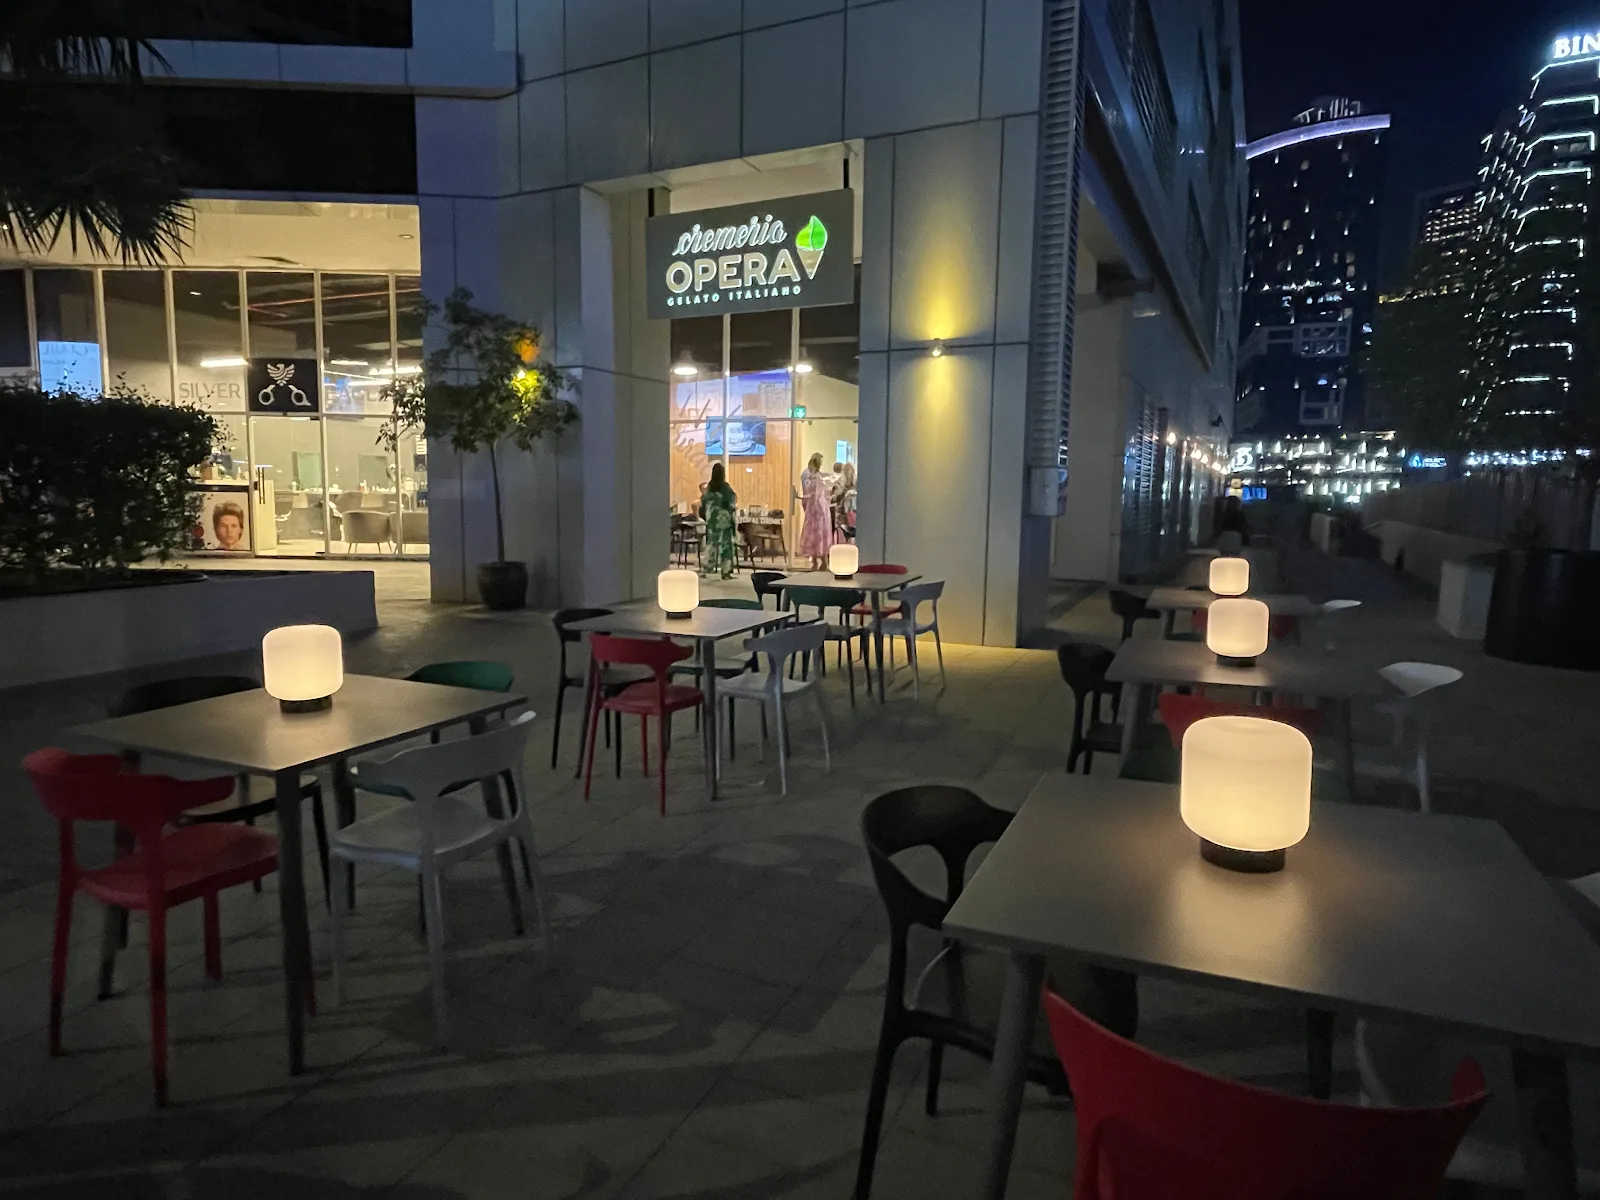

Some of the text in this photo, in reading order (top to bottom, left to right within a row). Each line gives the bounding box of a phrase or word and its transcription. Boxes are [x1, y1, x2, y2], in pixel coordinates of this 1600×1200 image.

[1553, 33, 1600, 58] BIN
[671, 214, 788, 256] cremeria
[665, 248, 801, 294] OPERA
[667, 285, 801, 307] GELATO ITALIANO
[179, 382, 241, 399] SILVER
